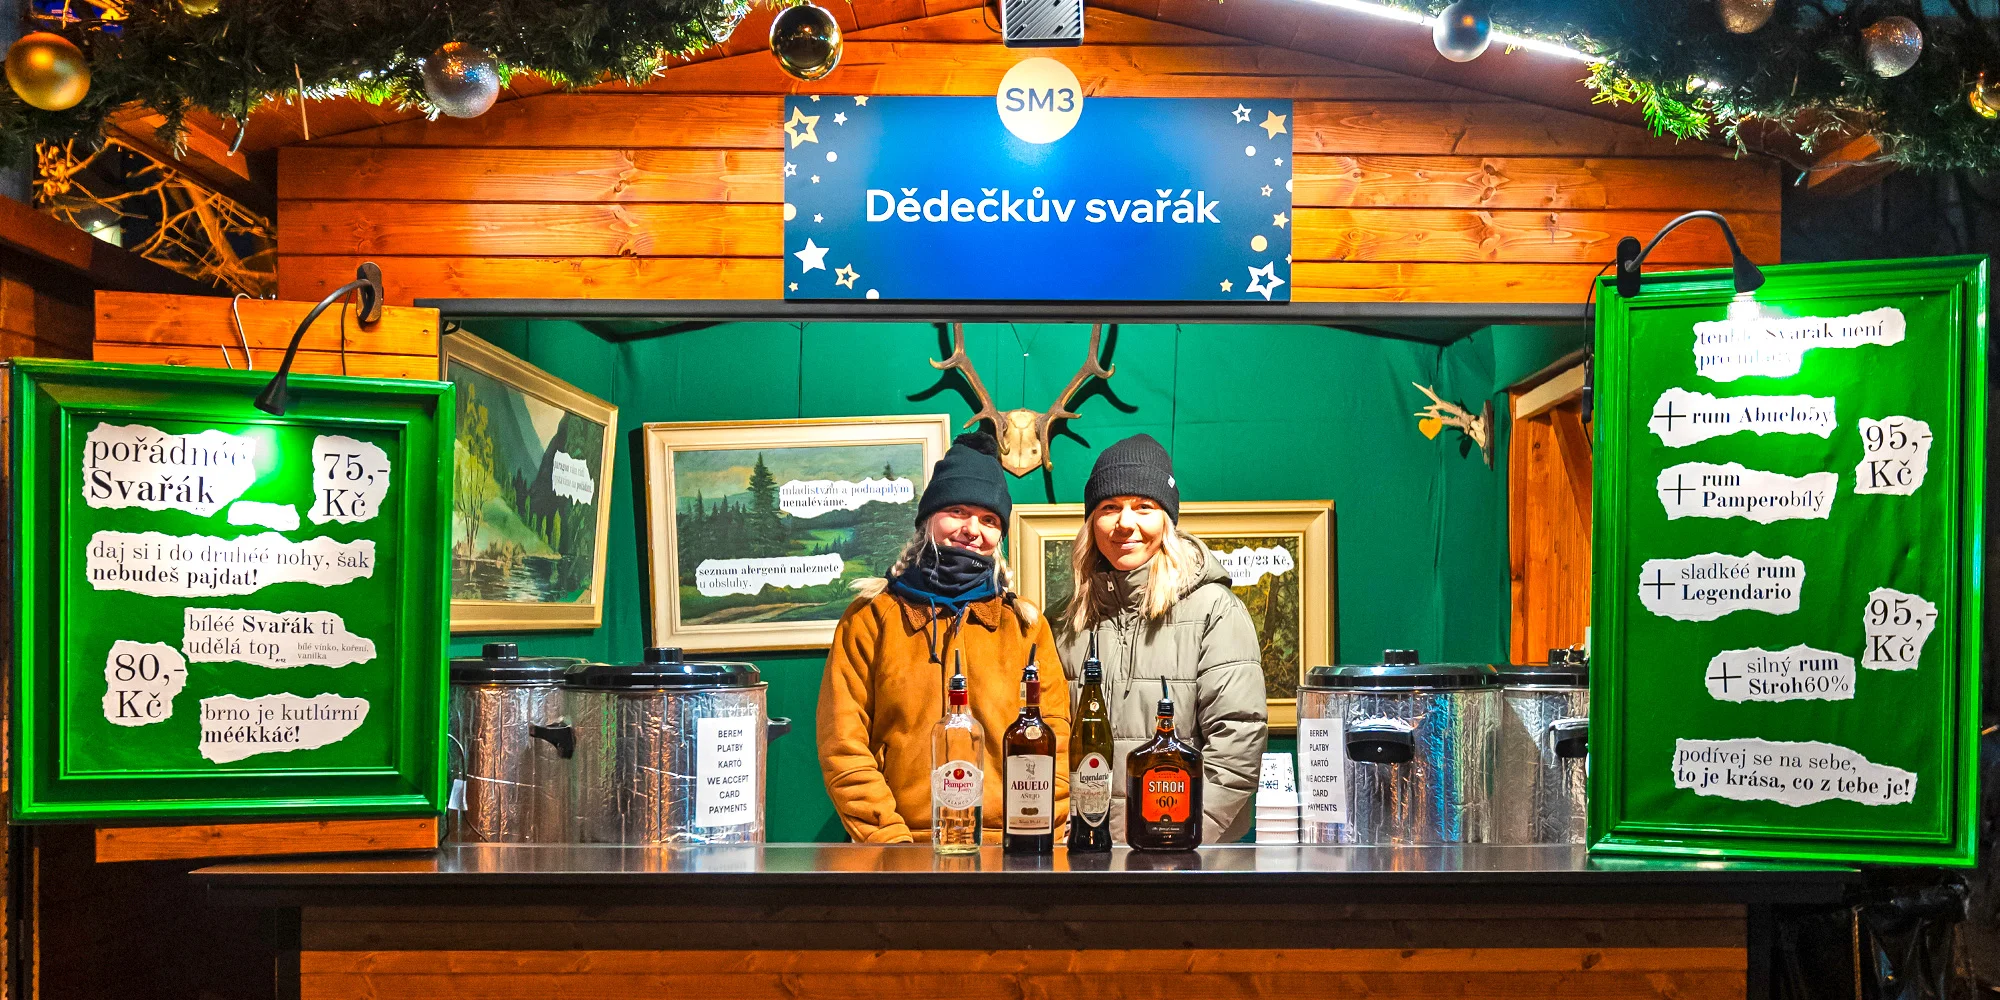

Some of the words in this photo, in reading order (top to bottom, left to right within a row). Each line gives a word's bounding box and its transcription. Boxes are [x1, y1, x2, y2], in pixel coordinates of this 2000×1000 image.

[1005, 86, 1075, 113] SM3
[866, 187, 1076, 224] Dědečkův
[1084, 188, 1220, 224] svařák
[1843, 320, 1884, 337] není
[1693, 411, 1731, 424] rum
[1865, 423, 1932, 454] 95,-
[89, 436, 248, 468] pořádnéé
[323, 453, 389, 486] 75,-
[1867, 459, 1913, 489] Kč
[90, 470, 215, 504] Svařák
[1702, 474, 1740, 487] rum
[841, 487, 848, 495] a
[851, 483, 909, 497] podnapilým
[322, 488, 367, 517] Kč
[783, 497, 847, 508] nenaléváme.
[93, 541, 124, 563] daj
[133, 543, 148, 560] si
[157, 544, 162, 560] i
[170, 544, 193, 561] do
[201, 546, 269, 563] druhéé
[277, 548, 330, 571] nohy,
[337, 551, 370, 569] šak
[94, 564, 179, 583] nebudeš
[186, 567, 258, 589] pajdat!
[699, 567, 738, 576] seznam
[741, 564, 787, 576] alergenů
[790, 563, 839, 574] naleznete
[1681, 563, 1750, 580] sladkéé
[1756, 565, 1796, 579] rum
[700, 580, 706, 588] u
[709, 578, 752, 590] obsluhy.
[1681, 583, 1791, 605] Legendario
[1870, 598, 1937, 630] 95,-
[189, 614, 234, 632] bíléé
[243, 615, 314, 634] Svařák
[322, 619, 334, 634] ti
[189, 637, 241, 655] udělá
[250, 639, 280, 659] top
[297, 642, 312, 651] bílé
[314, 643, 339, 652] vínko,
[341, 643, 369, 652] koření,
[1870, 635, 1915, 663] Kč
[297, 652, 327, 660] vanilka
[115, 653, 185, 686] 80,-
[1747, 656, 1791, 677] silný
[1798, 658, 1839, 672] rum
[115, 690, 162, 718] Kč
[205, 703, 250, 721] brno
[256, 704, 275, 725] je
[281, 703, 359, 721] kutlúrní
[204, 725, 300, 744] méékkáč!
[718, 729, 743, 738] BEREM
[1309, 729, 1329, 737] BEREM
[717, 743, 744, 752] PLATBY
[1309, 743, 1330, 752] PLATBY
[1679, 747, 1747, 769] podívej
[1753, 753, 1773, 767] se
[1779, 755, 1802, 768] na
[1808, 754, 1857, 775] sebe,
[707, 776, 721, 785] WE
[722, 774, 749, 785] ACCEPT
[943, 778, 974, 792] Pampero
[1010, 780, 1049, 791] ABUELO
[1148, 780, 1185, 793] STROH
[1314, 775, 1338, 783] ACCEPT
[1678, 767, 1696, 783] to
[1700, 767, 1719, 788] je
[1727, 769, 1786, 792] krása,
[1793, 776, 1814, 790] co
[1820, 779, 1831, 792] z
[1837, 776, 1879, 794] tebe
[1883, 778, 1911, 799] je!
[719, 789, 740, 799] CARD
[1020, 793, 1041, 801] AÑEJO
[1158, 795, 1175, 808] 60
[1312, 789, 1329, 798] CARD
[708, 803, 748, 814] PAYMENTS
[1307, 803, 1338, 812] PAYMENTS
